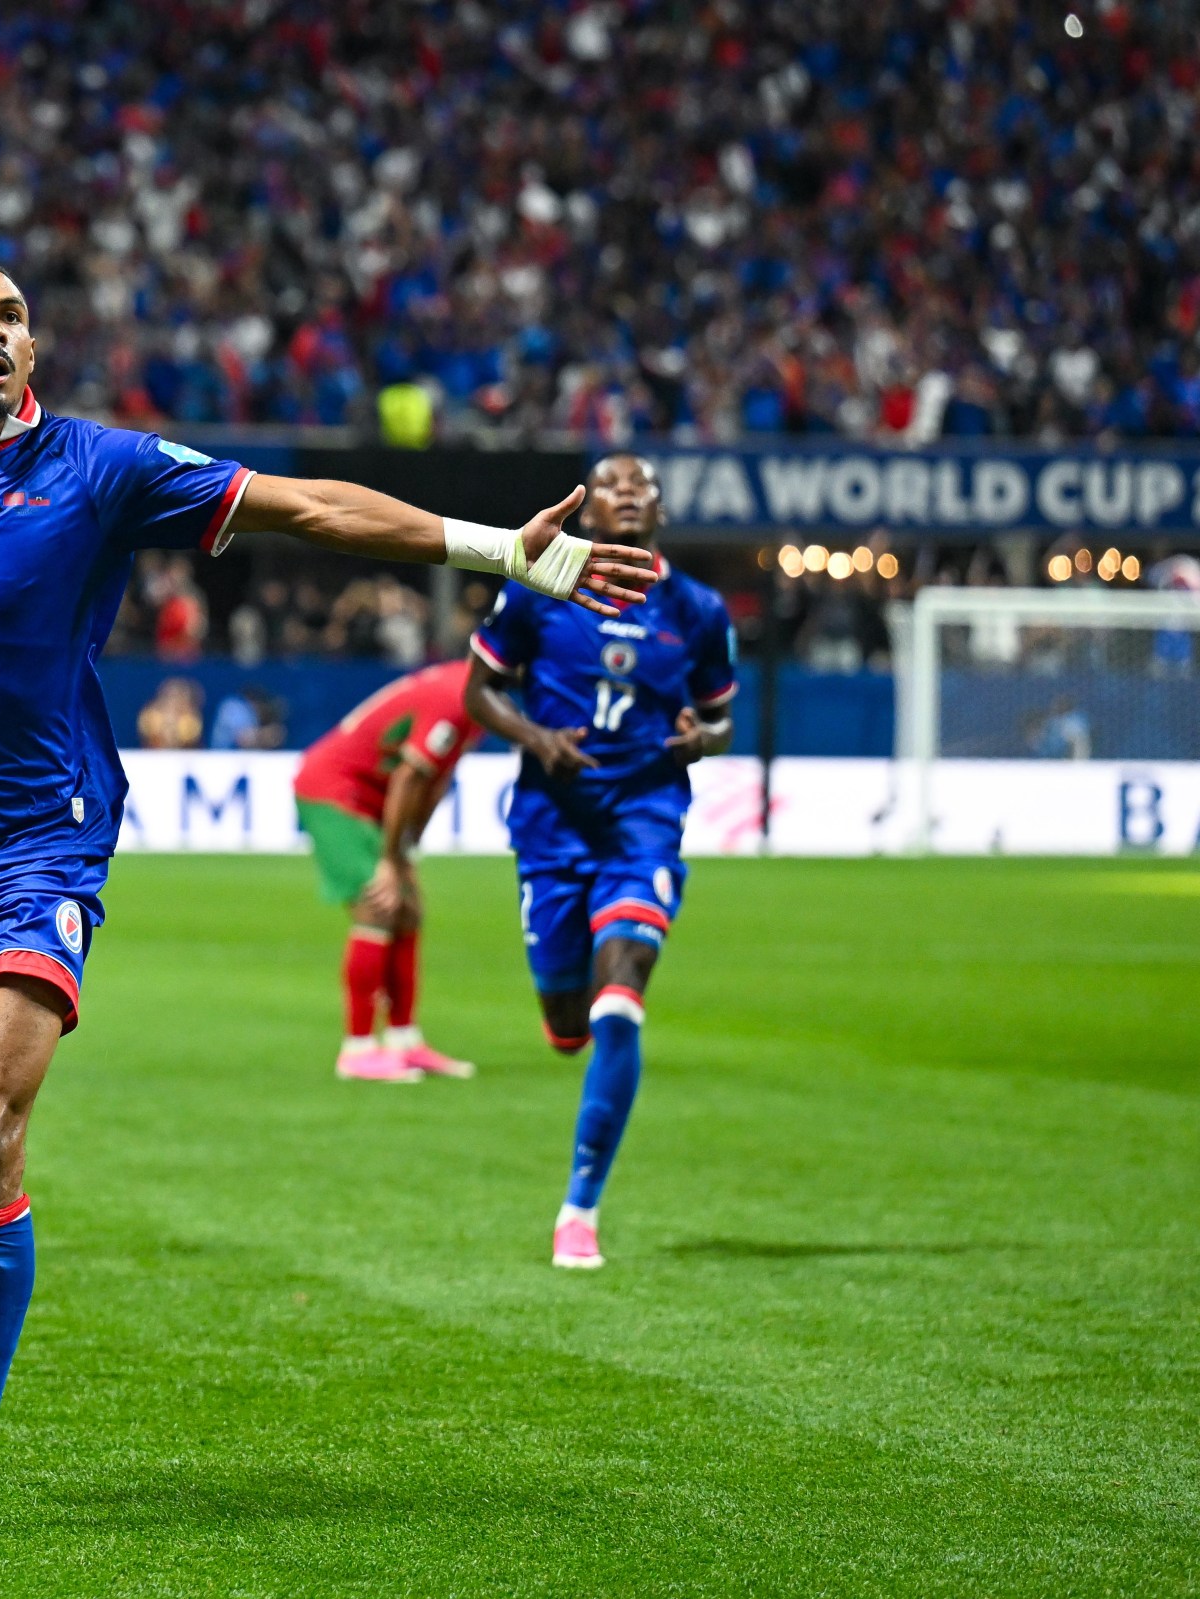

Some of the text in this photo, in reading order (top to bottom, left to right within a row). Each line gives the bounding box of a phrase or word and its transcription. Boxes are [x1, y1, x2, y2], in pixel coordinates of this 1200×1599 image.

[758, 455, 1030, 527] WORLD
[1035, 456, 1187, 526] CUP
[592, 680, 636, 732] 17
